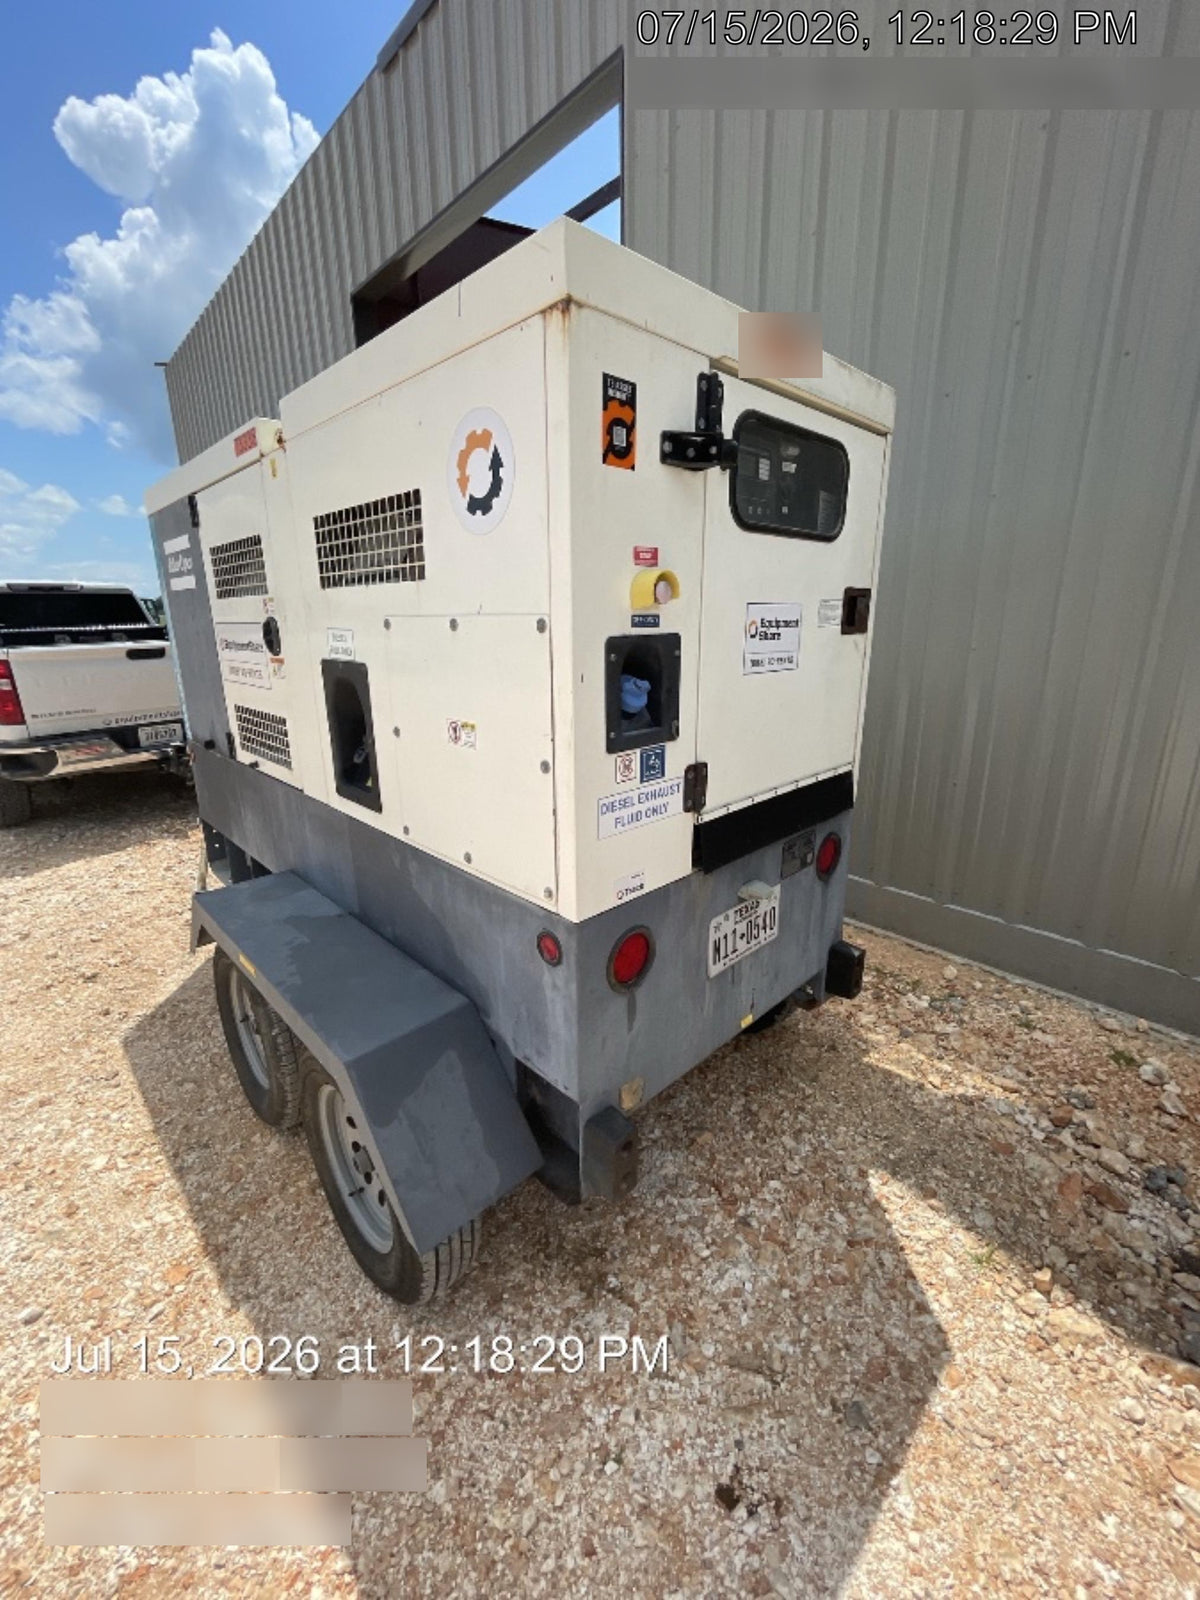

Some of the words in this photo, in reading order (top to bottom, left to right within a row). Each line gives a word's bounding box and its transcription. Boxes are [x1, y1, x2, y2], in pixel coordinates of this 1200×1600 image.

[601, 796, 635, 816] DIESEL
[638, 783, 681, 804] EXHAUST
[614, 810, 643, 829] FLUID
[645, 801, 669, 818] ONLY
